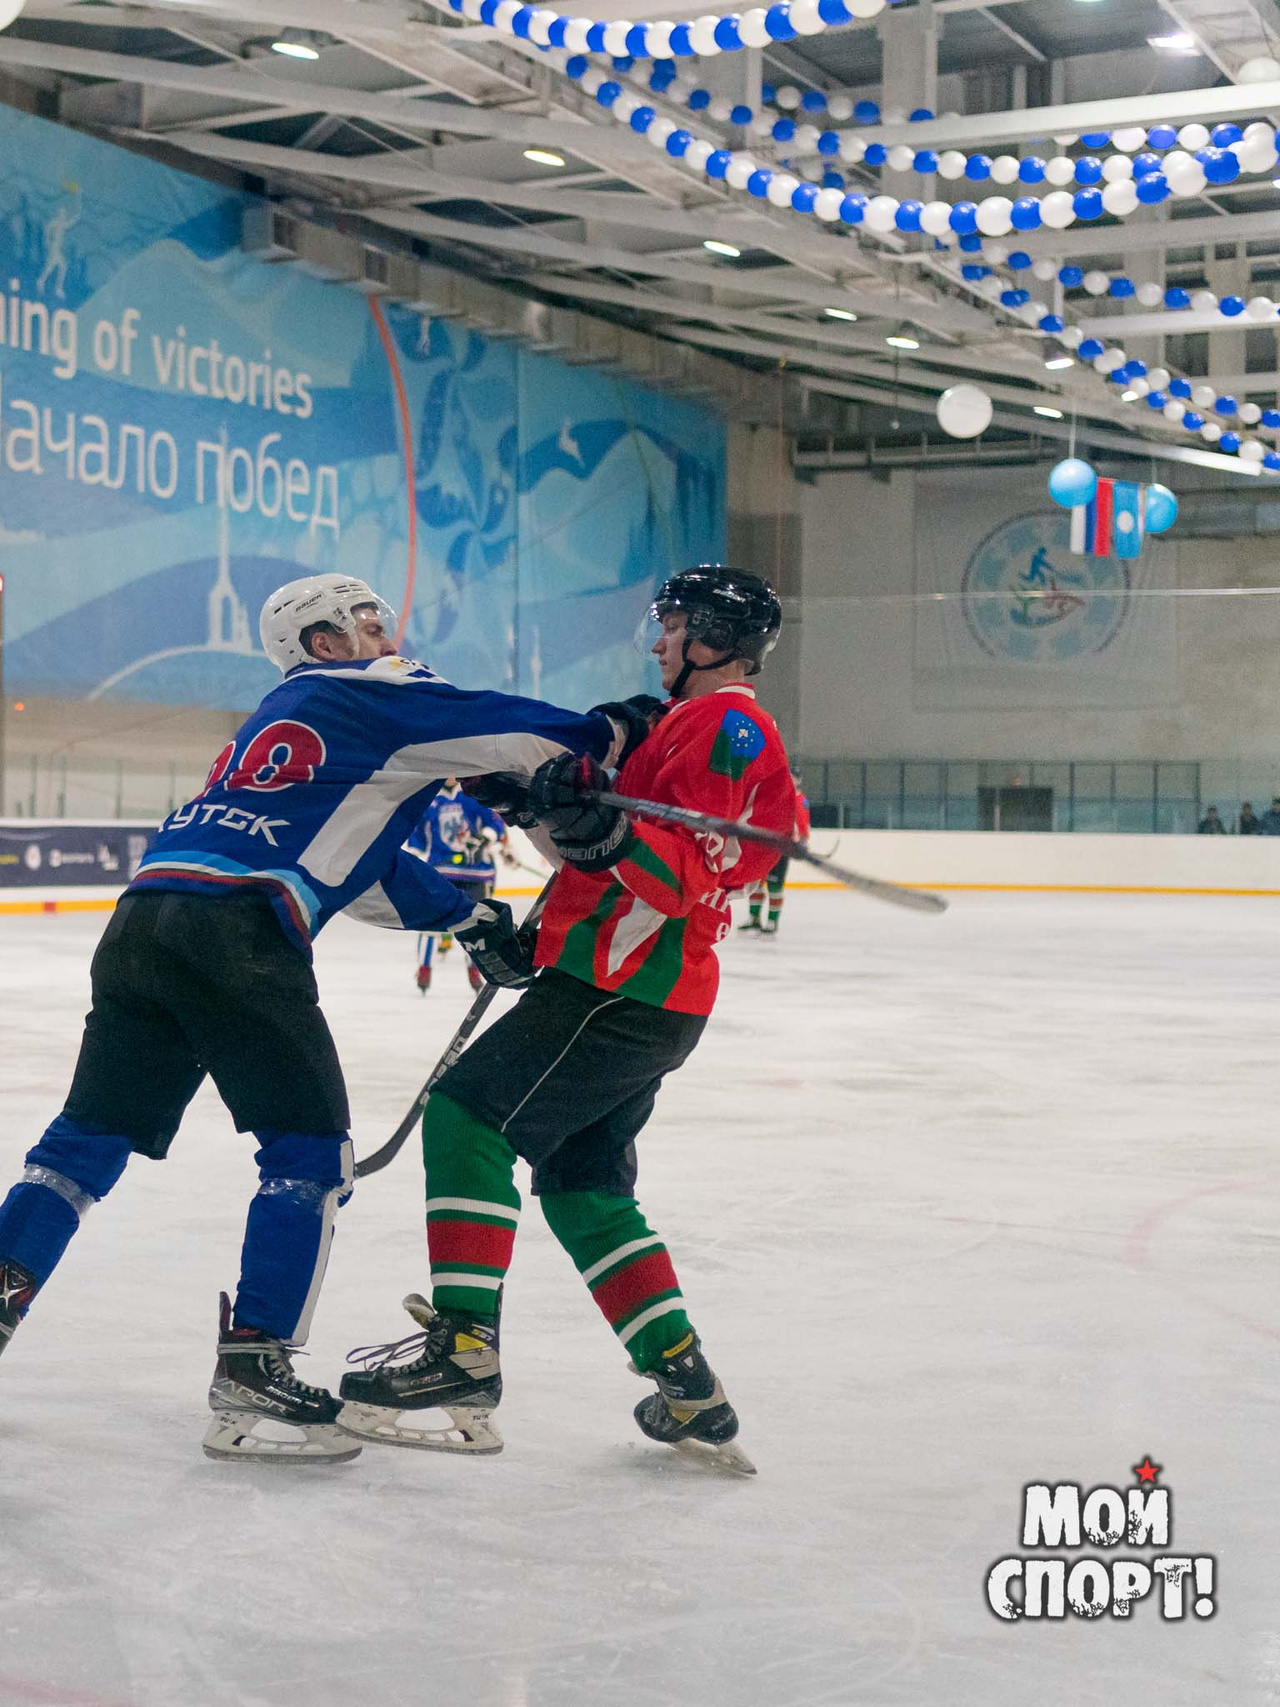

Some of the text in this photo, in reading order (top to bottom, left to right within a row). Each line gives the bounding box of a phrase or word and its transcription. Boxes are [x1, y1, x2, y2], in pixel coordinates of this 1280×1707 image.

[93, 307, 141, 377] of
[150, 325, 315, 419] victories
[195, 431, 341, 541] побед
[158, 803, 291, 847] УТСК
